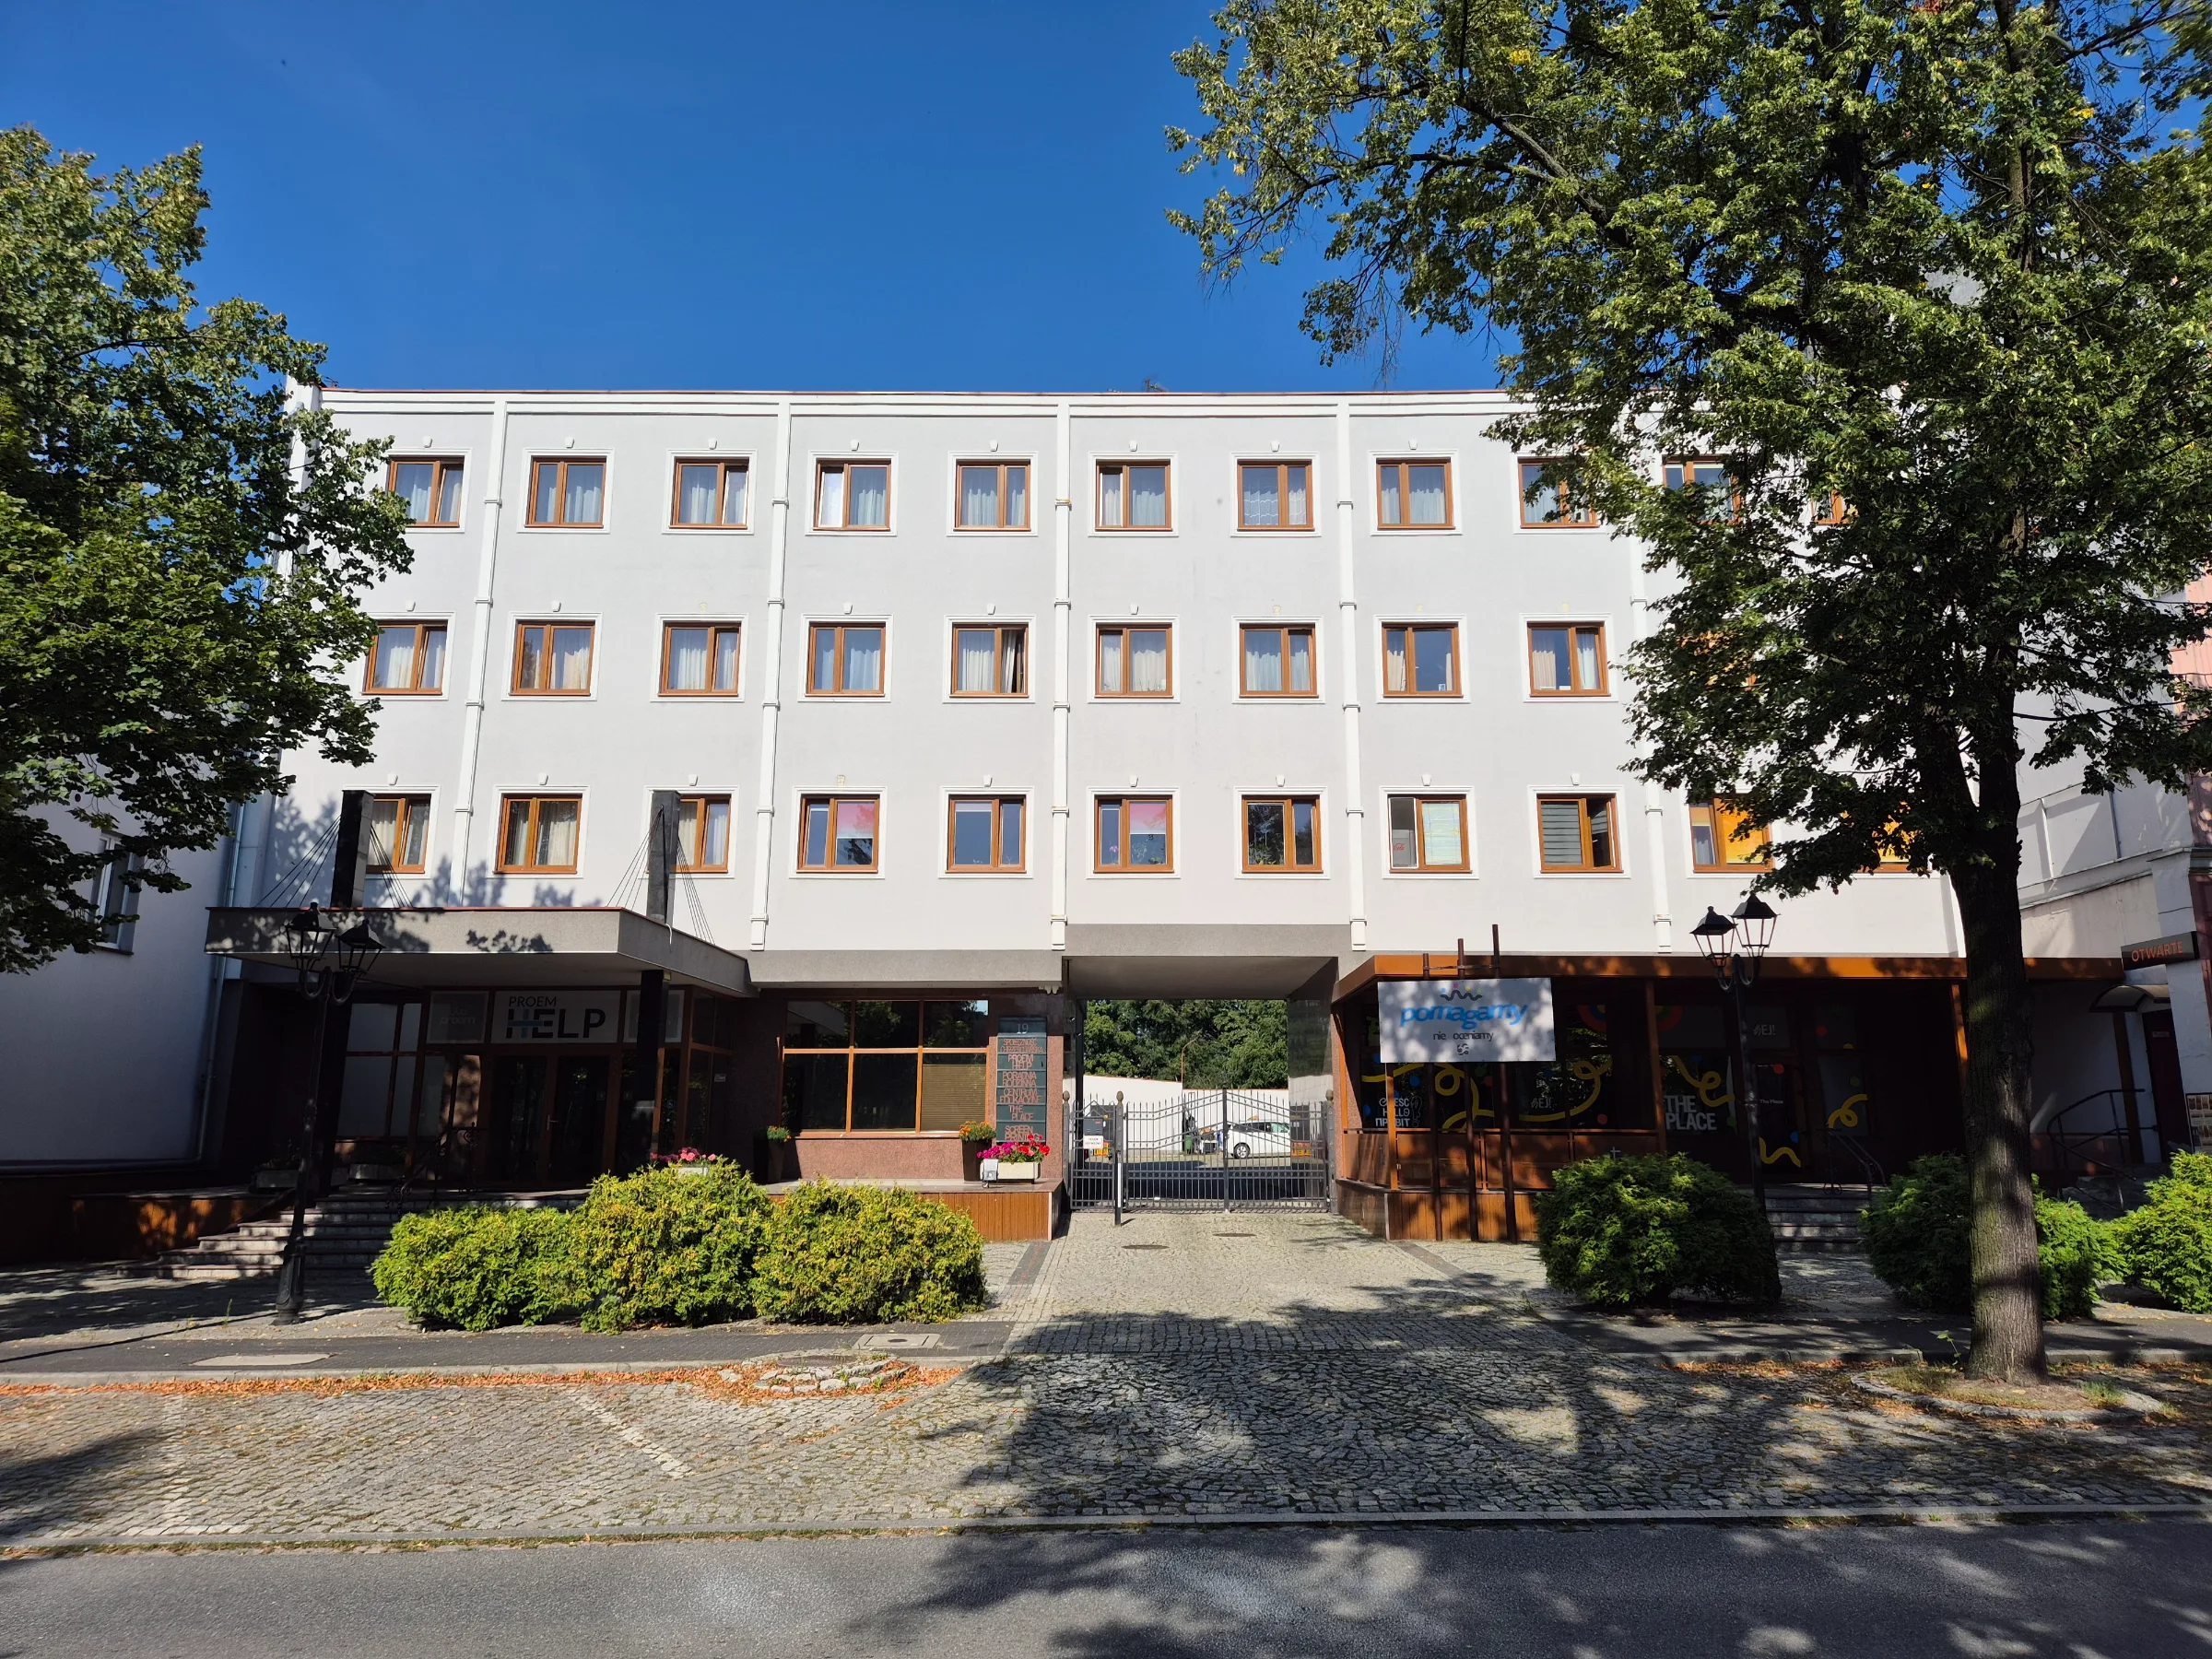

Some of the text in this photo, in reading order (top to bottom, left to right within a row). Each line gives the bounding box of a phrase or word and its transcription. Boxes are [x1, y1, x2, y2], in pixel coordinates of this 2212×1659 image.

[2131, 941, 2183, 962] OTWARTE
[509, 995, 557, 1007] PROEM
[1400, 1004, 1528, 1030] pomagamy
[506, 1008, 606, 1039] HELP
[1016, 1023, 1029, 1034] 19
[1433, 1030, 1493, 1042] nie oceniamy
[1007, 1053, 1034, 1063] PROEM
[1012, 1062, 1032, 1070] HELP
[1004, 1088, 1038, 1096] CENTRUM
[1008, 1104, 1024, 1113] THE
[1664, 1094, 1697, 1113] THE
[1012, 1112, 1034, 1122] PLACE
[1382, 1108, 1410, 1117] HLLO
[1374, 1117, 1410, 1127] ПРВІТ
[1665, 1112, 1718, 1131] PLACE
[1005, 1124, 1034, 1134] SCREEN
